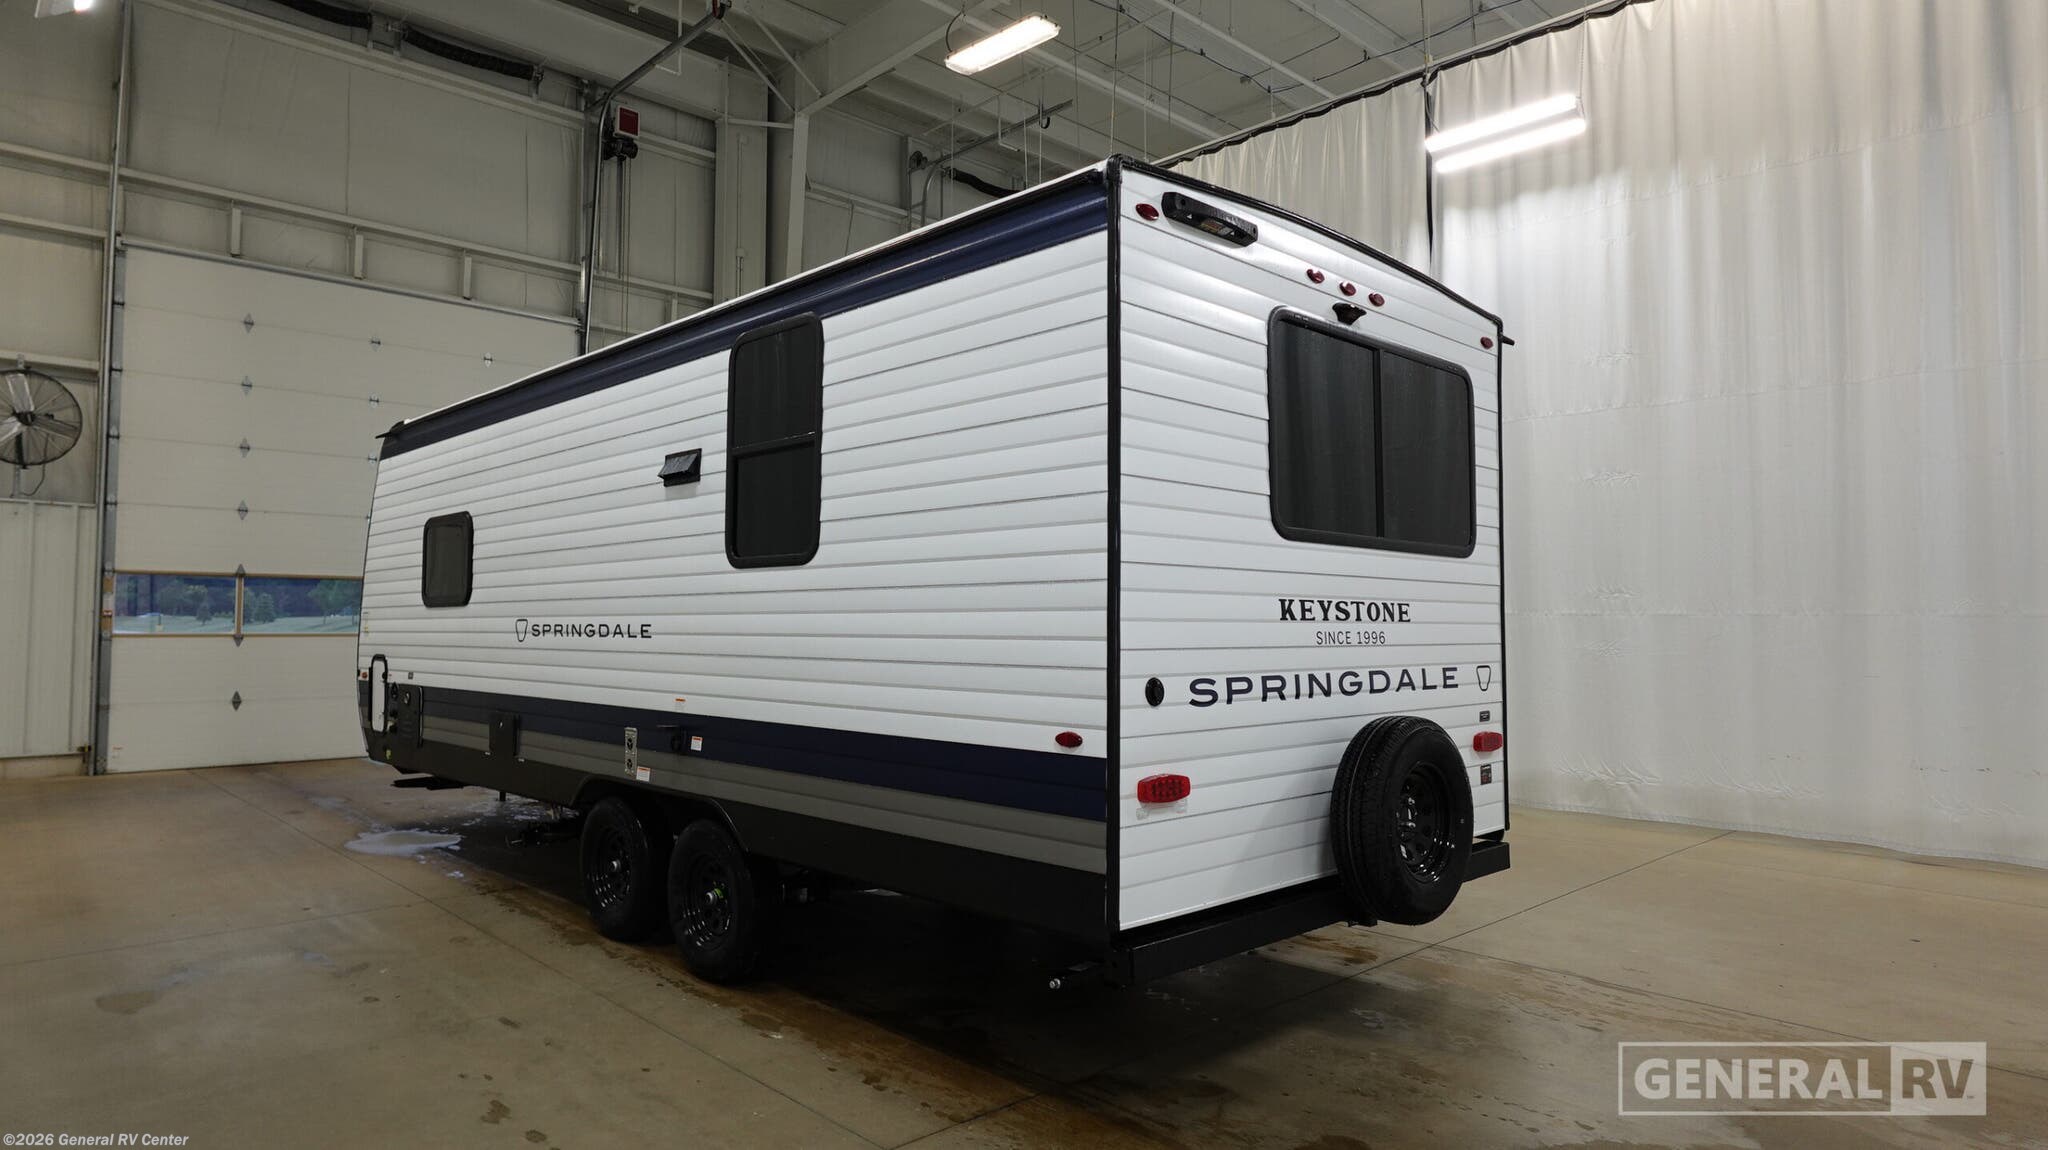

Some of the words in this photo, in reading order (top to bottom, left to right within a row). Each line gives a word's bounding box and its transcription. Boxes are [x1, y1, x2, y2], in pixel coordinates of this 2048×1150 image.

[1278, 598, 1411, 622] KEYSTONE
[531, 623, 652, 639] SPRINGDALE
[1315, 630, 1352, 645] SINCE
[1357, 630, 1386, 645] 1996
[1188, 666, 1459, 708] SPRINGDALE
